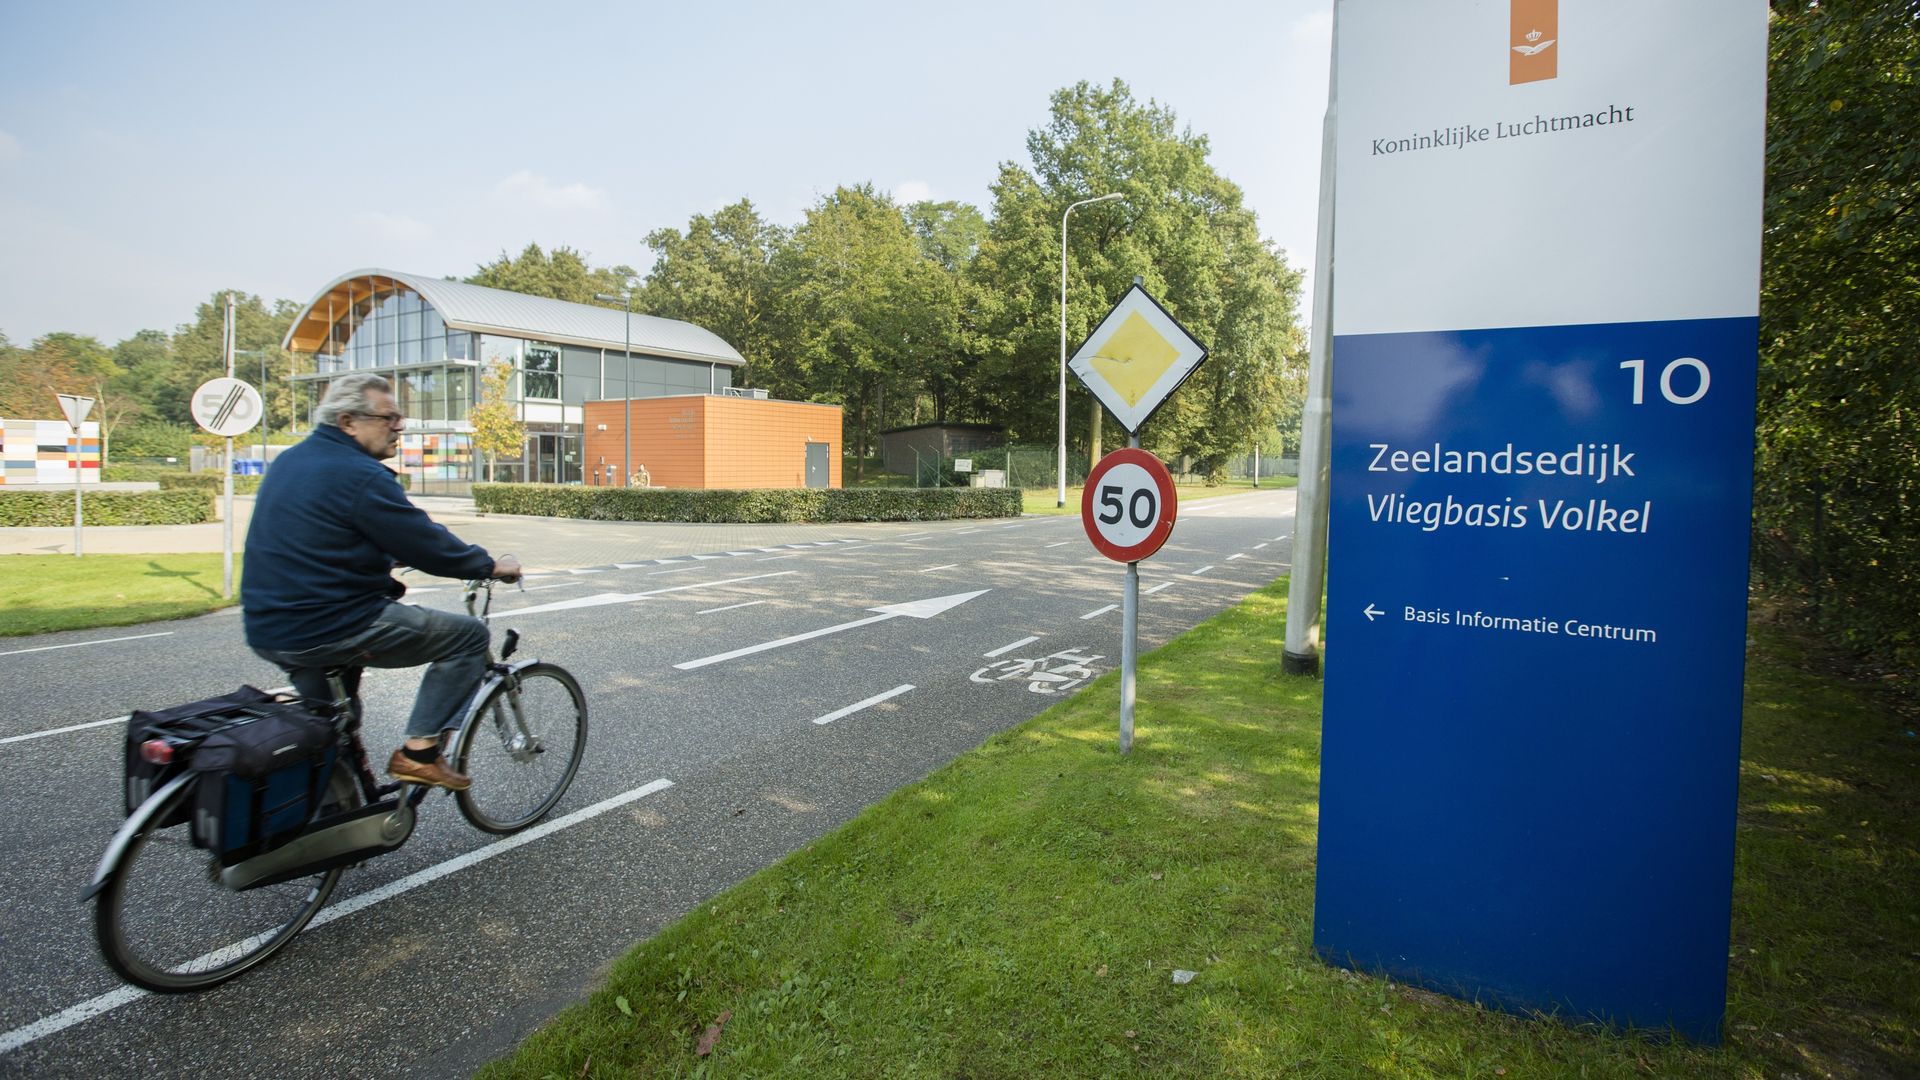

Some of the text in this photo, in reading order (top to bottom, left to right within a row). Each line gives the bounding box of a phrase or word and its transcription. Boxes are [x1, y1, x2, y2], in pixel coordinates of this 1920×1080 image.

[1371, 104, 1635, 156] Koninklijke Luchtmacht
[1619, 357, 1711, 406] 10
[202, 394, 253, 420] 50
[1368, 442, 1636, 484] Zeelandsedijk
[1098, 485, 1156, 529] 50
[1367, 493, 1652, 534] Vliegbasis Volkel
[1404, 605, 1657, 643] Basis Informatie Centrum
